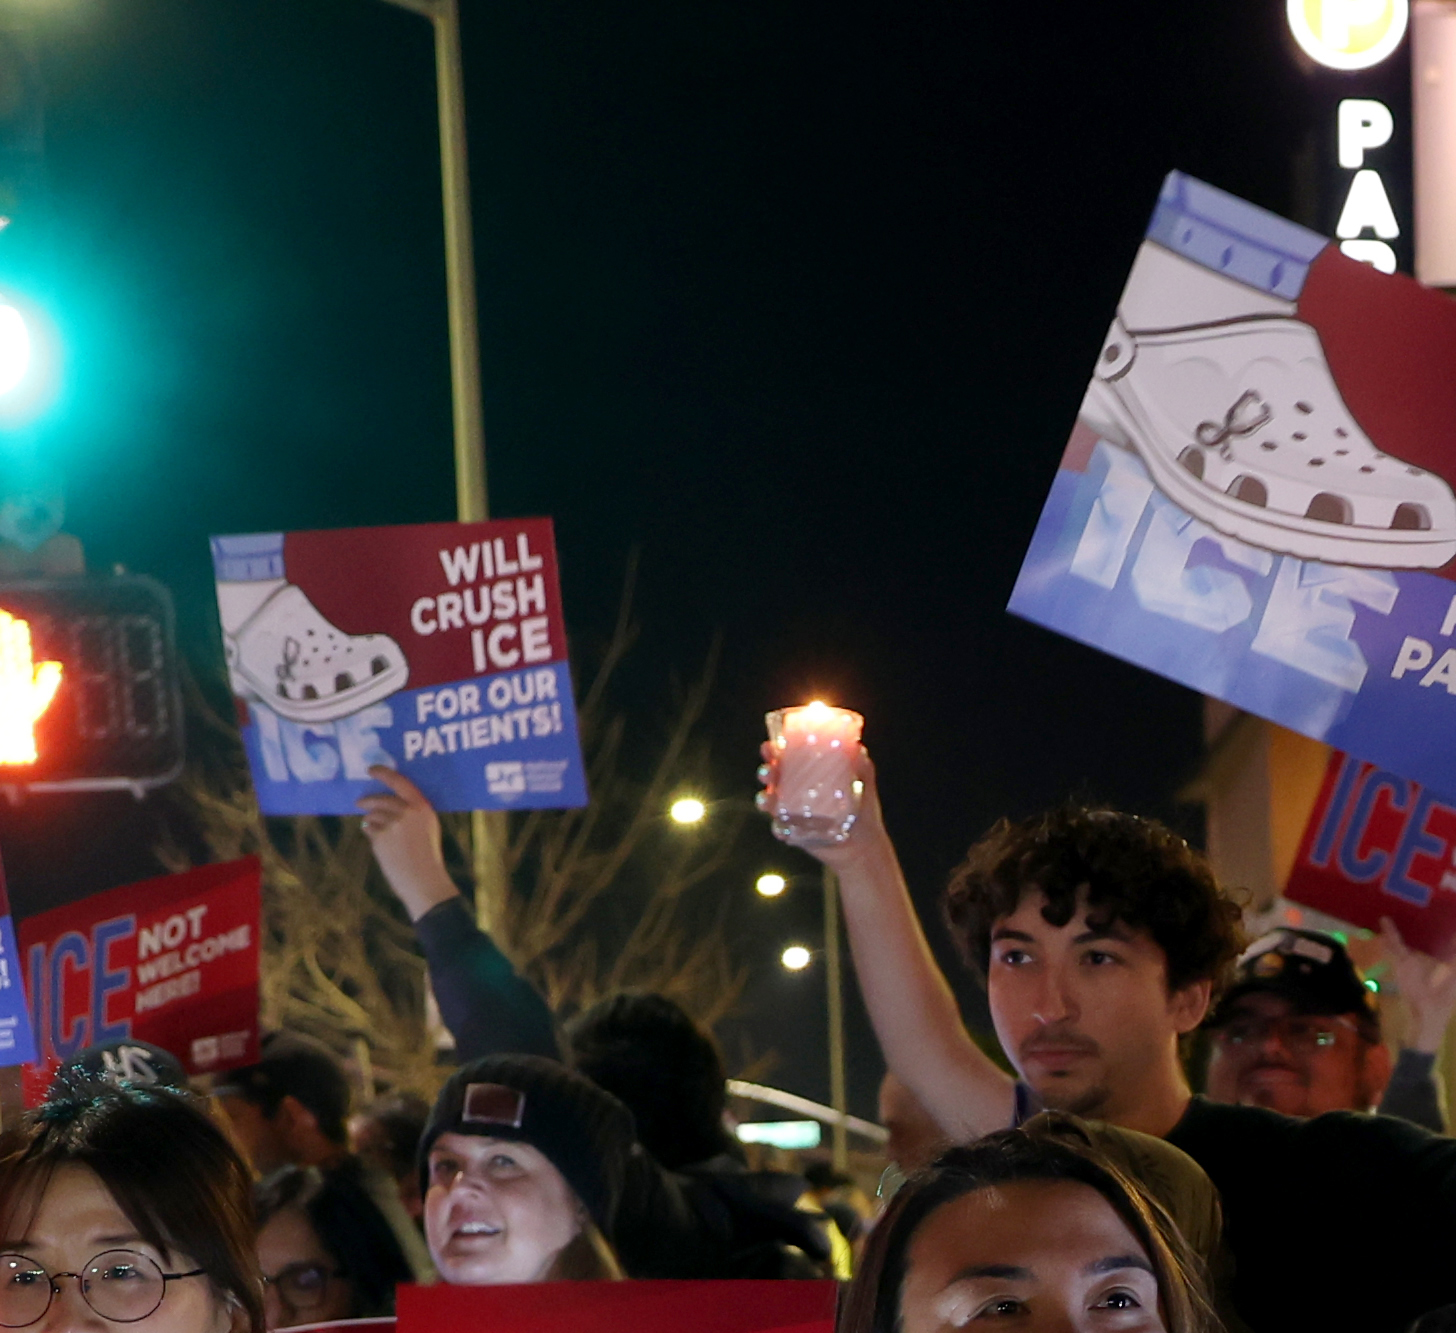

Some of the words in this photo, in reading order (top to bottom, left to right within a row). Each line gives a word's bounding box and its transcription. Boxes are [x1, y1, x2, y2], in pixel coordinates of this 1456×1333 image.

[439, 533, 544, 585] WILL
[1069, 440, 1399, 694] ICE
[410, 577, 546, 636] CRUSH
[471, 616, 552, 673] ICE
[416, 684, 481, 724] FOR
[487, 670, 557, 710] OUR
[403, 701, 563, 762] PATIENTS!
[137, 924, 252, 985] WELCOME
[138, 904, 207, 957] NOT
[27, 914, 137, 1071] ICE
